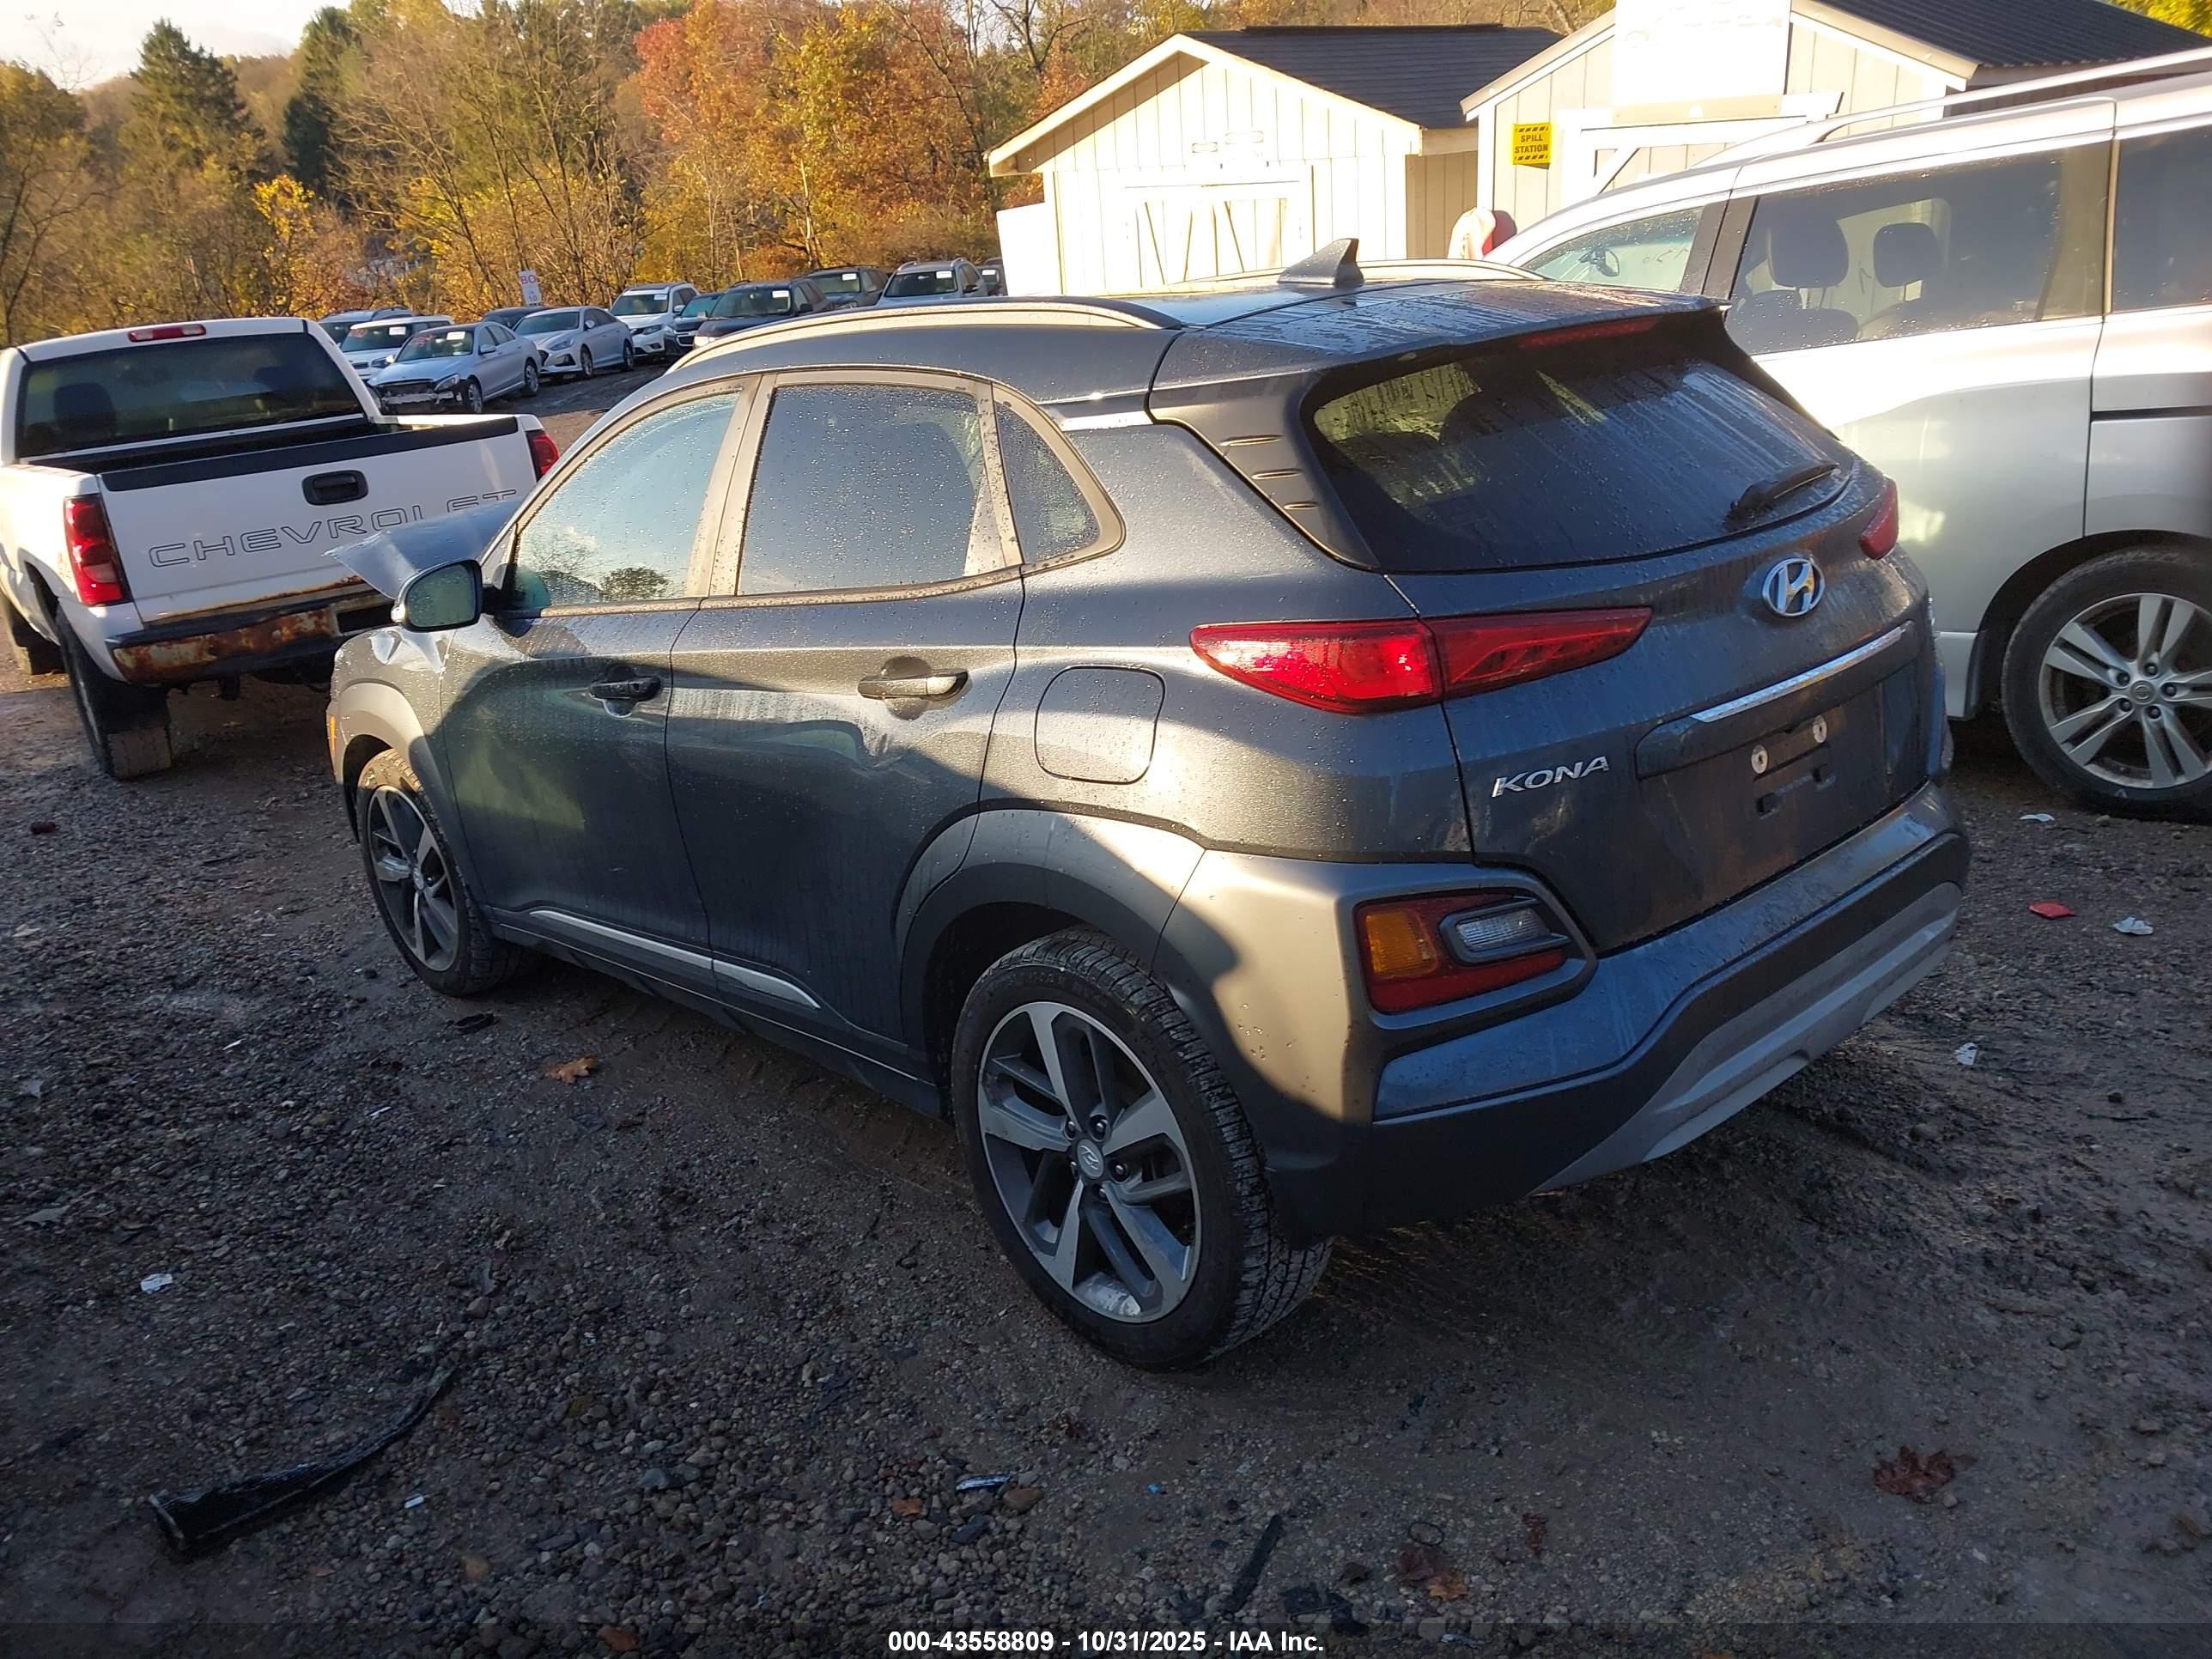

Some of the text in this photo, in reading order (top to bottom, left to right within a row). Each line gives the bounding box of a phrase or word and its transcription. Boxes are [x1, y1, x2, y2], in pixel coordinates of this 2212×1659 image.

[1521, 134, 1543, 143] SPILL
[1515, 144, 1548, 153] STATION
[1492, 756, 1610, 798] KONA
